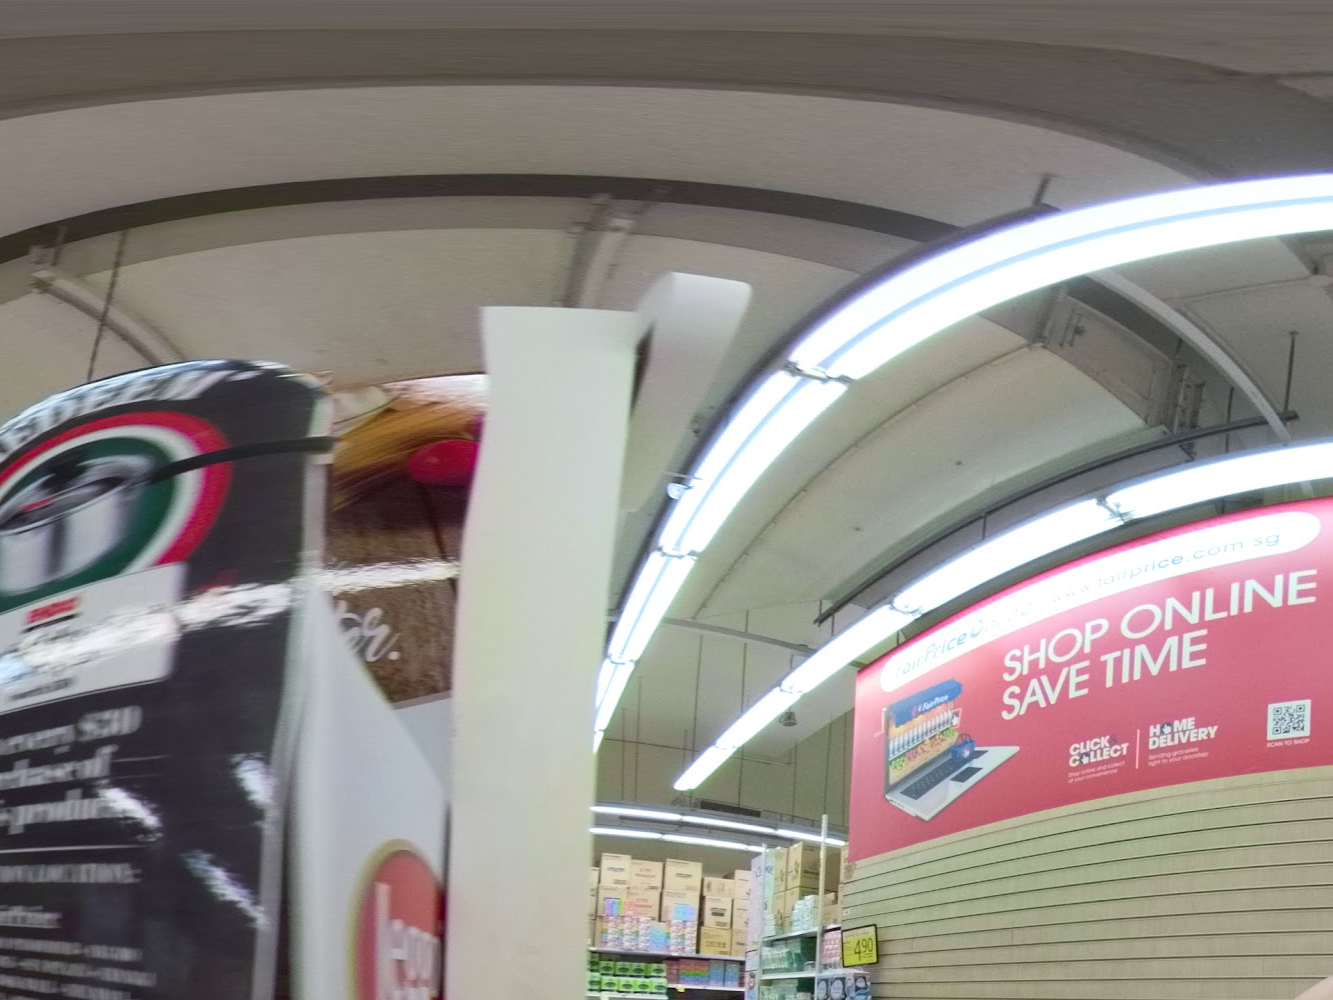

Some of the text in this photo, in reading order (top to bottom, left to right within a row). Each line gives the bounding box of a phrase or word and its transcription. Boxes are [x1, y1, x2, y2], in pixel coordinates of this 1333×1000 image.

[1002, 569, 1318, 682] SHOP ONLINE
[1001, 629, 1208, 720] SAVE TIME
[1069, 736, 1110, 756] CLICK
[1148, 726, 1218, 750] DELIVERY
